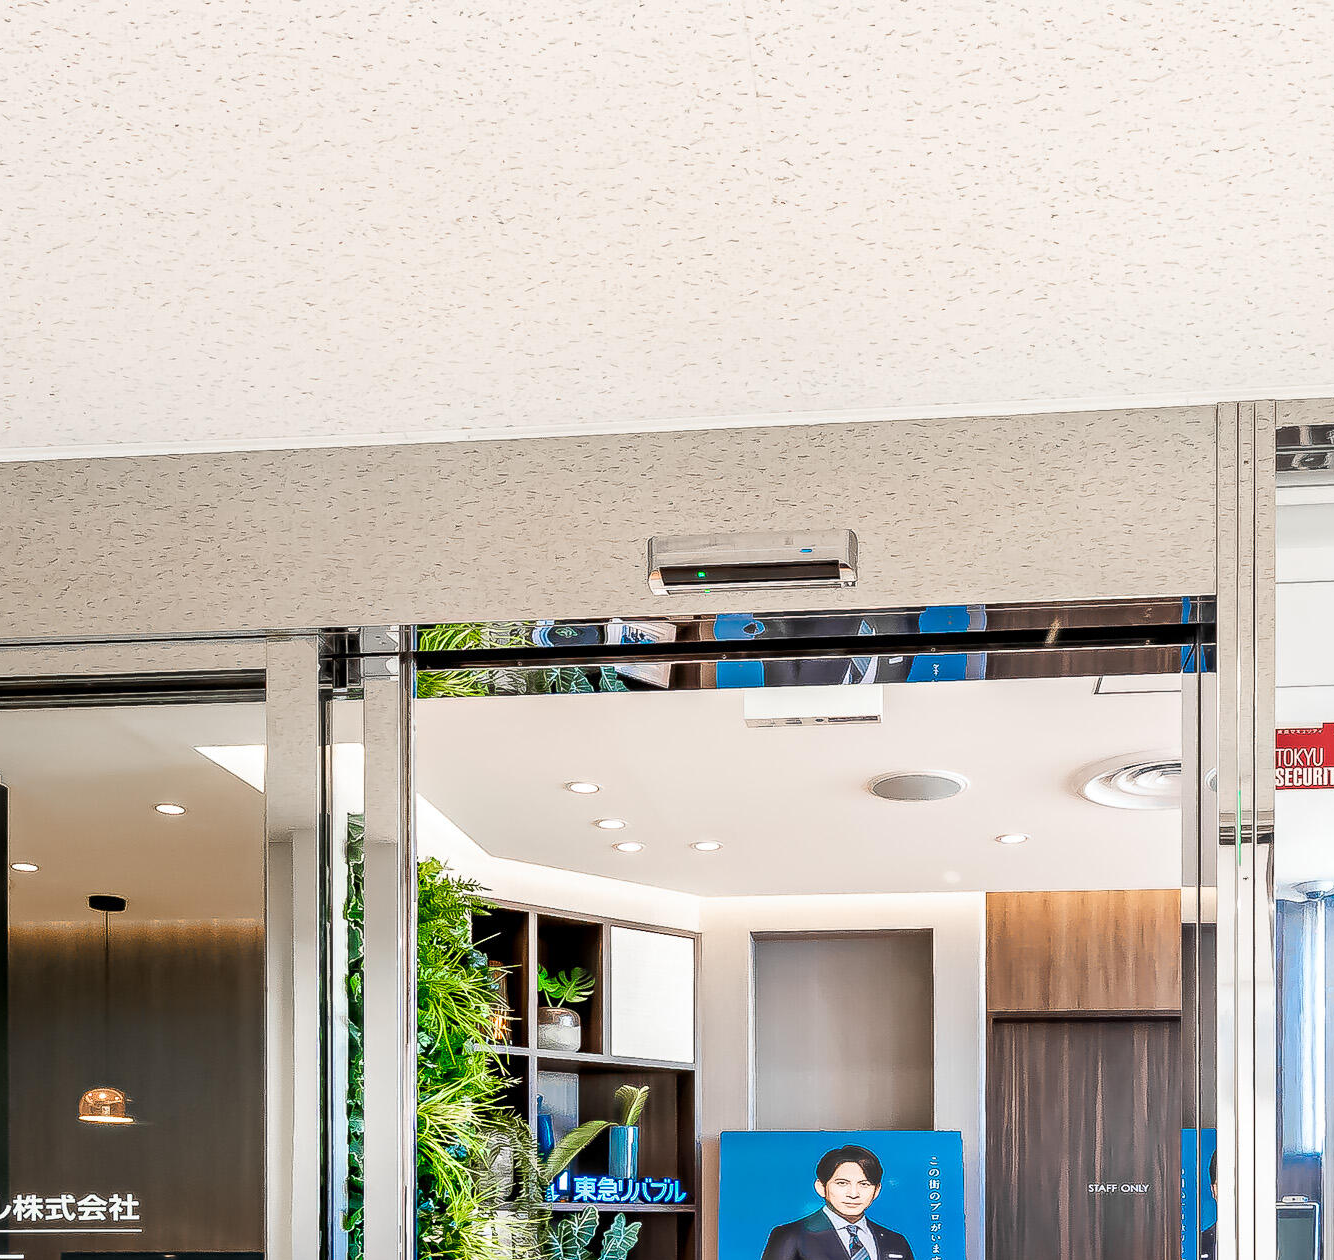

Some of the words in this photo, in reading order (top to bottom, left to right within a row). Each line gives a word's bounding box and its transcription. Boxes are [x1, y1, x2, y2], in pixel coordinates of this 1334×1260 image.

[1275, 747, 1324, 767] TOKYU
[573, 1176, 687, 1203] 東急リバブル
[1088, 1184, 1118, 1193] STAFF
[1120, 1184, 1150, 1193] ONLY
